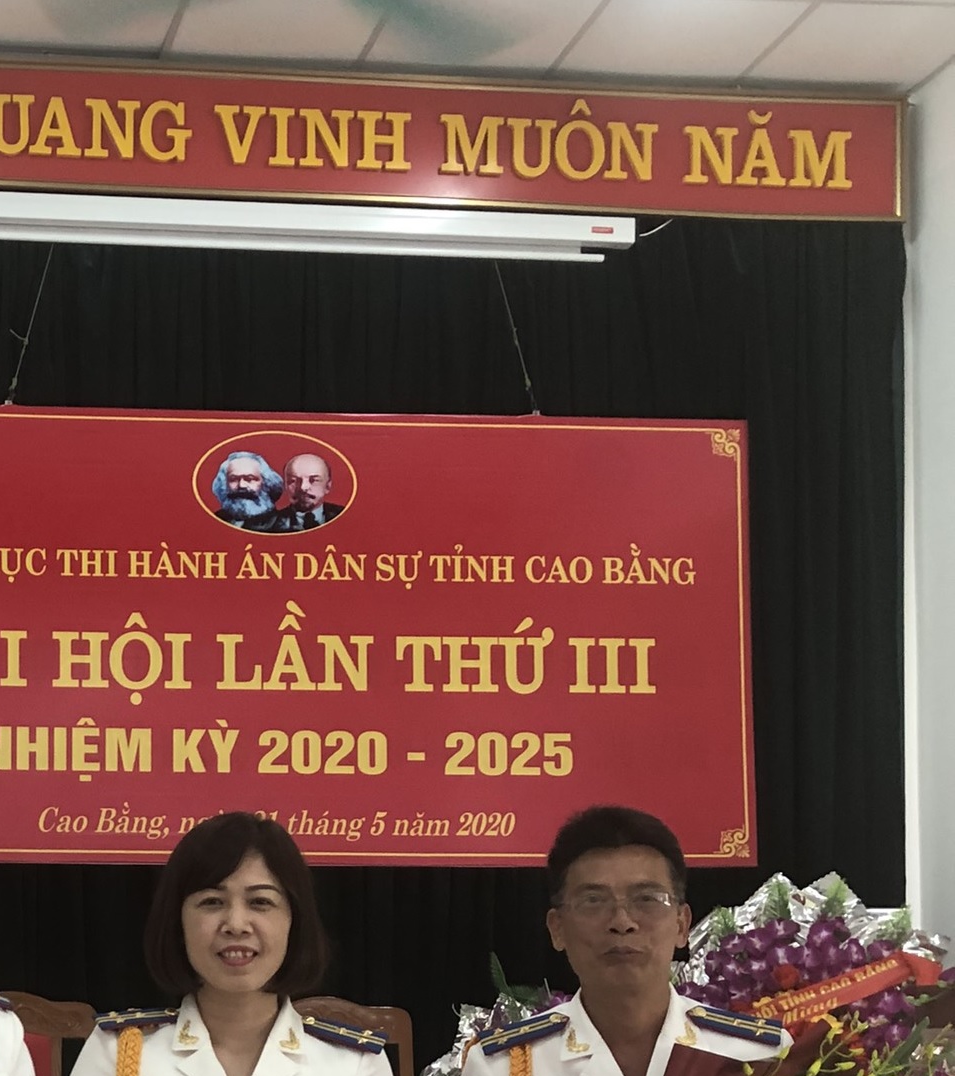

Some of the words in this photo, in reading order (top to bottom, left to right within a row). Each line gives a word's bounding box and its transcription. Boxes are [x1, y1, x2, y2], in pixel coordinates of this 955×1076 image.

[213, 104, 411, 171] VINH
[440, 99, 658, 181] MUÔN
[683, 111, 852, 190] NĂM
[56, 549, 116, 578] THI
[129, 544, 226, 580] HÀNH
[237, 544, 283, 580] ÁN
[295, 543, 366, 582] DÂN
[375, 551, 423, 590] SỰ
[429, 544, 513, 583] TỈNH
[525, 556, 593, 585] CAO
[603, 543, 696, 586] BẰNG
[52, 612, 192, 705] HỘI
[216, 600, 374, 693] LẦN
[395, 617, 554, 695] THỨ
[567, 637, 656, 694] III
[172, 719, 239, 774] KỲ
[257, 730, 388, 776] 2020
[406, 752, 425, 762] -
[444, 732, 573, 777] 2025
[38, 808, 88, 833] Cao
[95, 802, 170, 839] Bằng,
[287, 810, 364, 841] tháng
[371, 811, 387, 836] 5
[392, 813, 450, 836] năm
[457, 812, 516, 838] 2020
